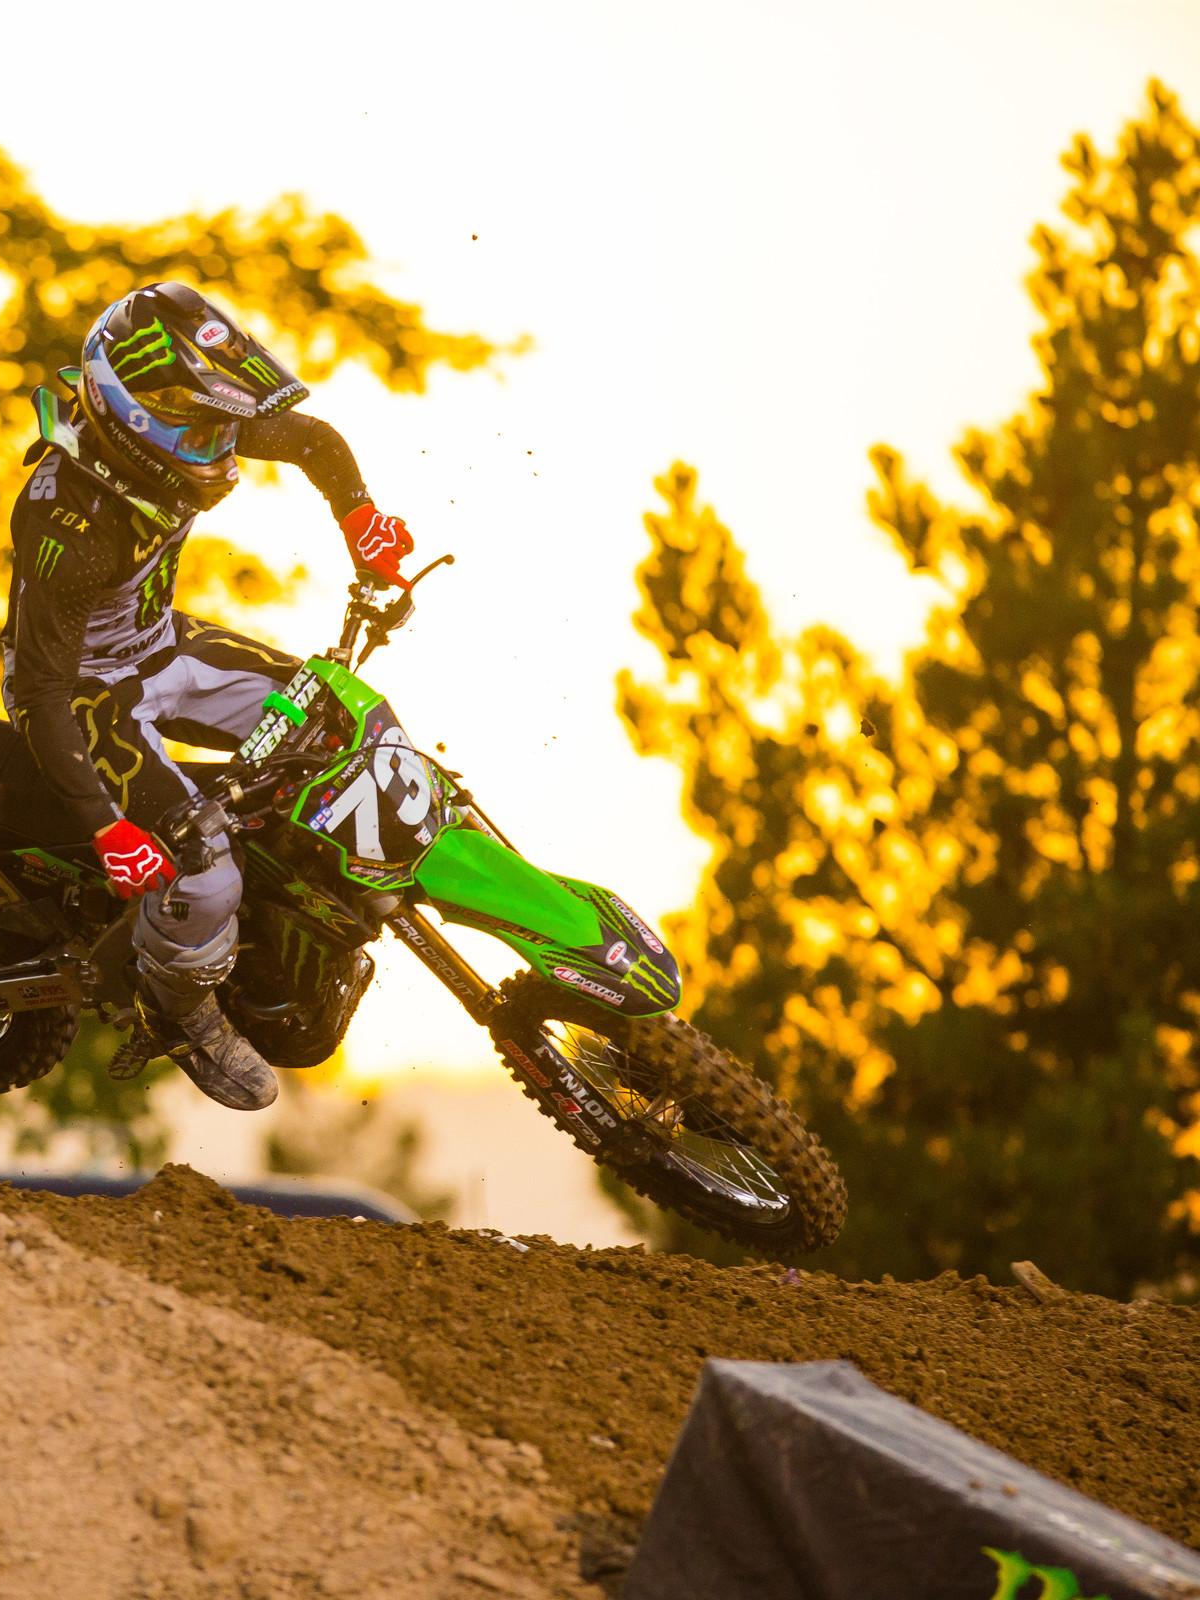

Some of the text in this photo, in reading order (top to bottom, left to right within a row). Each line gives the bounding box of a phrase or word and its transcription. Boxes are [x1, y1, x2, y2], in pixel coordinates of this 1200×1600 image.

[201, 325, 223, 343] BELL
[108, 421, 164, 472] MONSTER
[50, 507, 90, 533] FOX
[323, 726, 431, 862] 73
[393, 916, 428, 947] PRO
[421, 946, 476, 997] CIRCUIT
[574, 975, 626, 1004] MAXIMA
